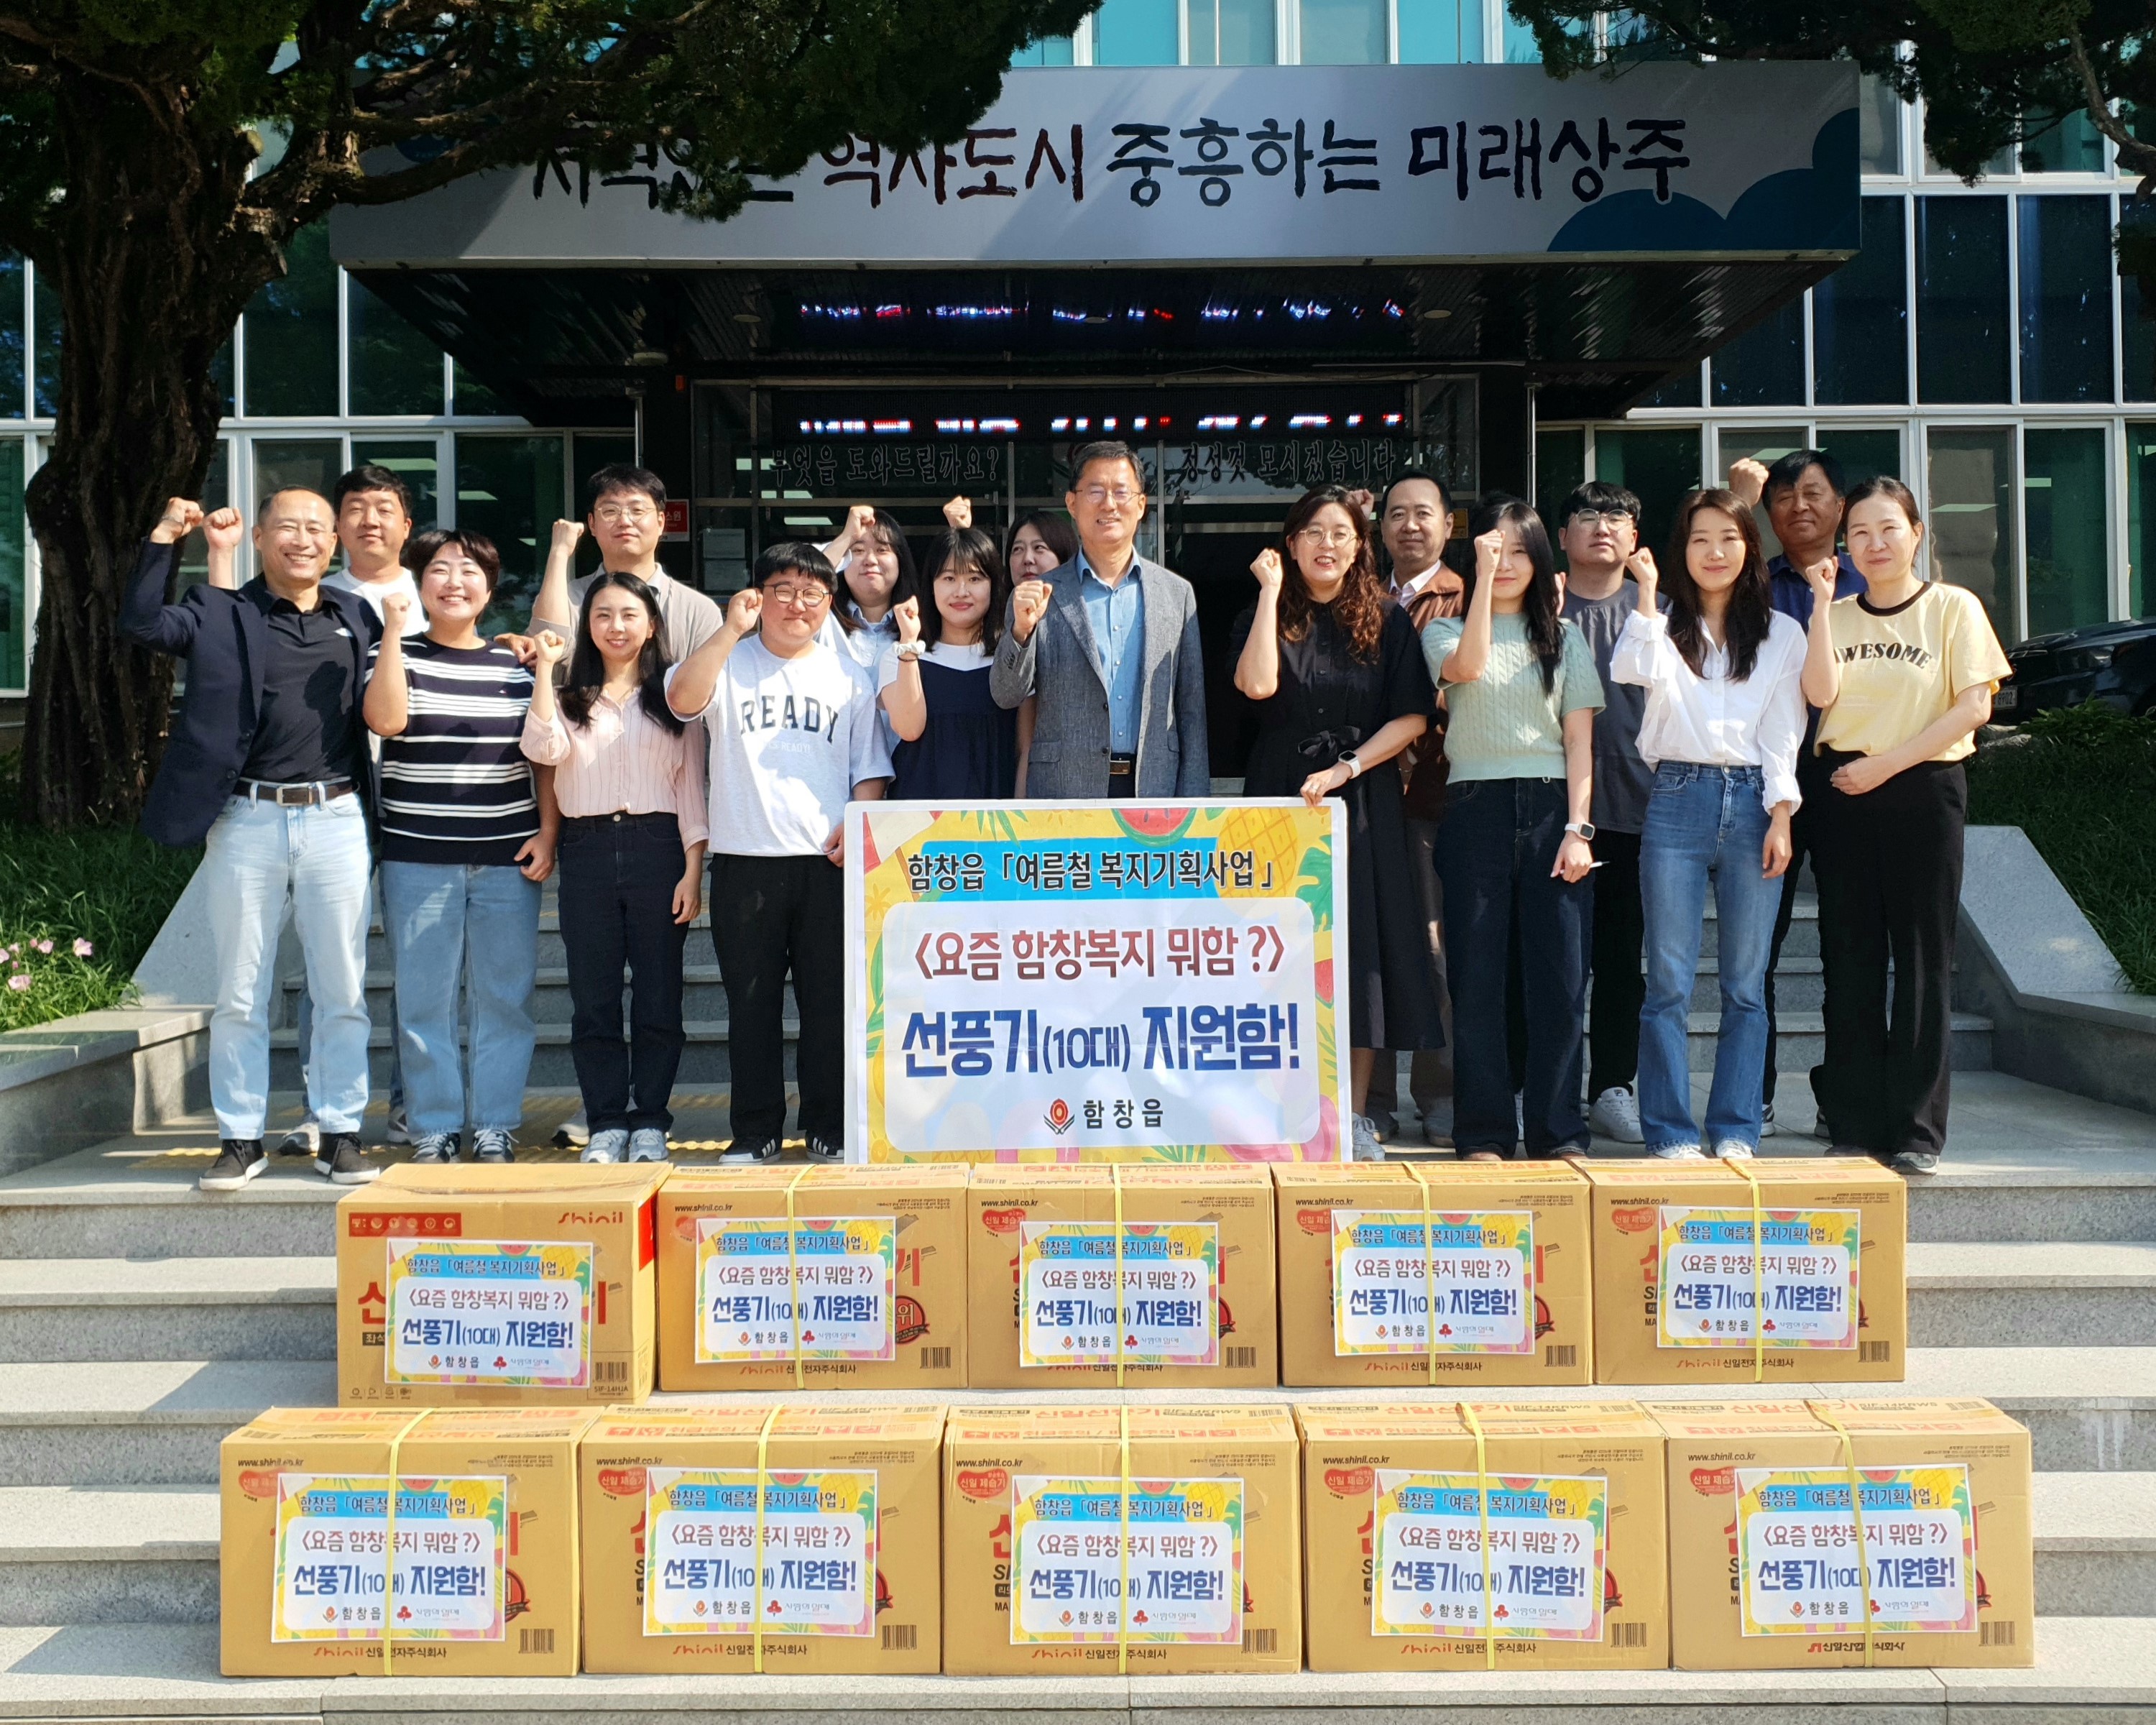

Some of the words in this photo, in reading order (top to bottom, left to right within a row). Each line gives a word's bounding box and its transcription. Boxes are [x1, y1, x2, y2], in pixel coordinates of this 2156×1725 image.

[822, 124, 1083, 208] 역사도시
[1105, 117, 1380, 206] 중흥하는
[1408, 116, 1690, 203] 미래상주
[769, 443, 837, 487] 무엇을
[846, 443, 998, 486] 도와드릴까요?
[1181, 441, 1247, 484] 정성껏
[1257, 438, 1396, 482] 모시겠습니다
[741, 695, 838, 743] READY
[908, 852, 986, 893] 함창읍
[1013, 928, 1155, 981] 함창복지
[1143, 1003, 1300, 1070] 지원함!
[981, 1199, 1038, 1208] www.shinil.co.kr
[1296, 1197, 1353, 1206] www.shinil.co.kr
[1352, 1229, 1383, 1243] 함창읍
[1679, 1225, 1711, 1239] 함창읍
[717, 1236, 748, 1251] 함창읍
[1039, 1241, 1071, 1254] 함창읍
[407, 1258, 440, 1273] 함창읍
[451, 1289, 512, 1310] 함창복지
[1450, 1289, 1516, 1315] 지원함!
[1775, 1285, 1841, 1312] 지원함!
[814, 1294, 877, 1321] 지원함!
[1136, 1300, 1201, 1326] 지원함!
[506, 1320, 573, 1348] 지원함!
[786, 1364, 857, 1374] 신전자주식회사
[1411, 1362, 1482, 1371] 신일자주식회사
[596, 1457, 662, 1466] www.shinil.co.kr
[956, 1458, 1023, 1467] www.shinil.co.kr
[1323, 1455, 1390, 1464] www.shinil.co.kr
[1688, 1453, 1756, 1461] www.shinil.co.kr
[960, 1478, 977, 1488] 신일
[1327, 1476, 1345, 1485] 신일
[300, 1496, 336, 1512] 함창읍
[669, 1489, 706, 1506] 함창읍
[1397, 1491, 1434, 1509] 함창읍
[1759, 1490, 1797, 1507] 함창읍
[1034, 1499, 1072, 1516] 함창읍
[410, 1565, 485, 1596] 지원함!
[780, 1560, 856, 1591] 지원함!
[1508, 1564, 1584, 1597] 지원함!
[1877, 1557, 1955, 1588] 지원함!
[1147, 1570, 1222, 1600] 지원함!
[1455, 1643, 1537, 1654] 신일전주식회사
[1823, 1642, 1905, 1652] 신일산업식회사
